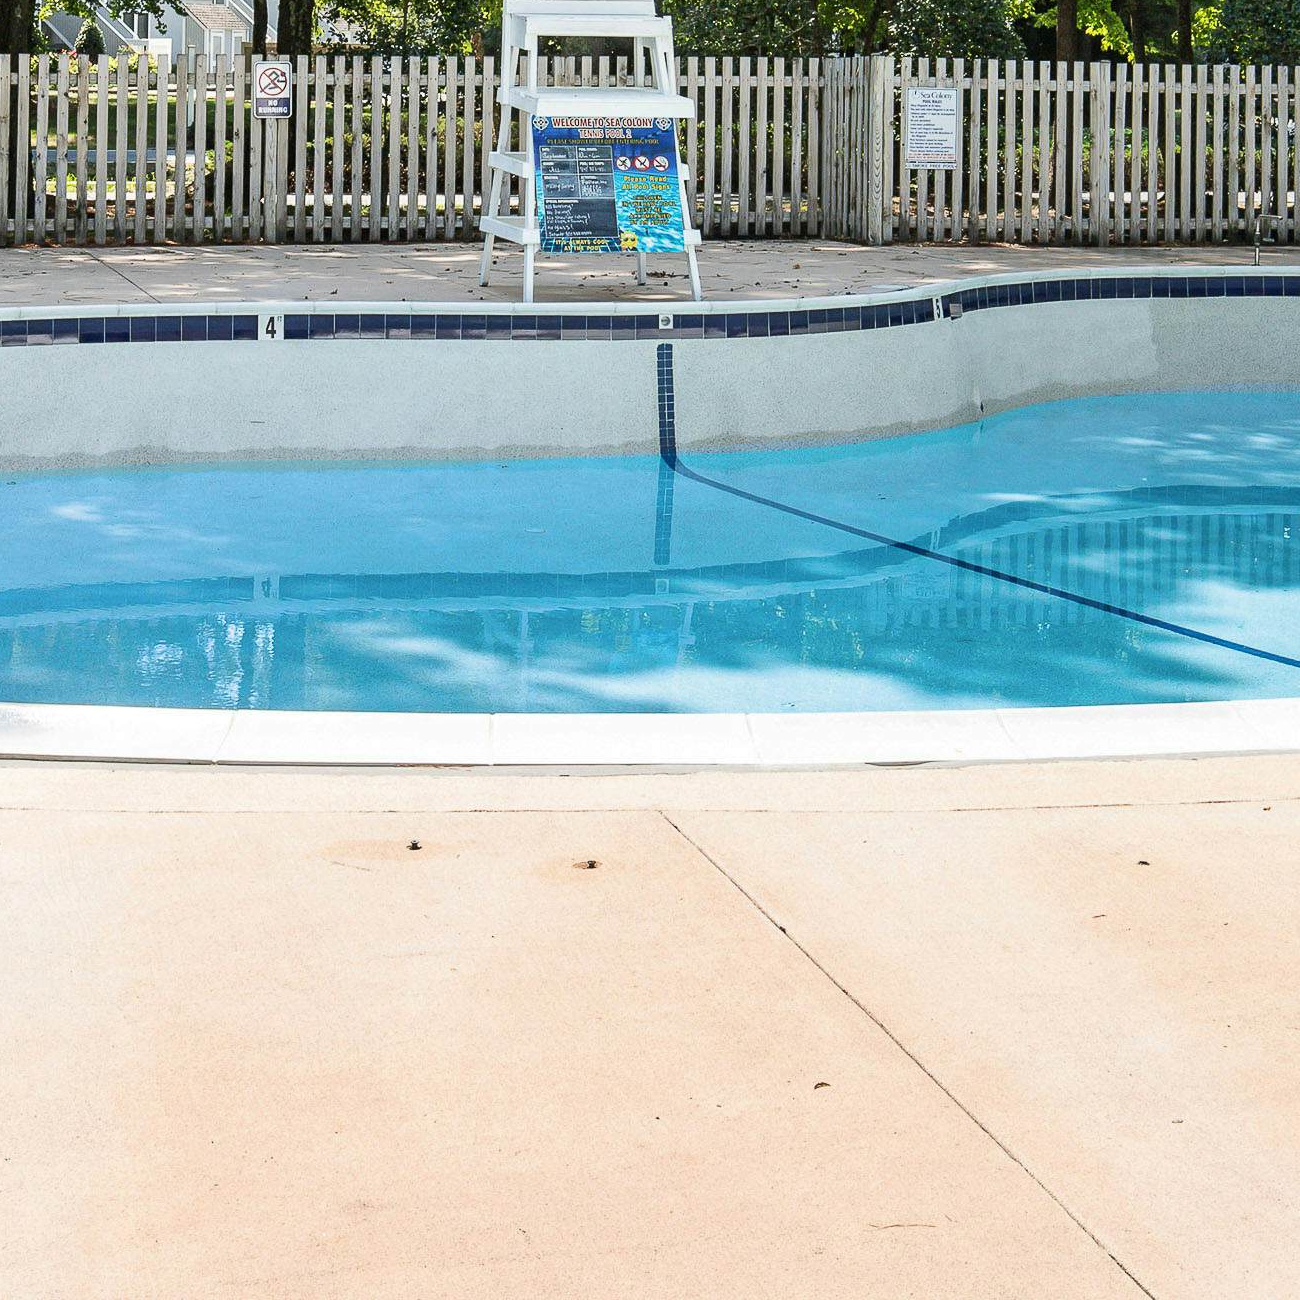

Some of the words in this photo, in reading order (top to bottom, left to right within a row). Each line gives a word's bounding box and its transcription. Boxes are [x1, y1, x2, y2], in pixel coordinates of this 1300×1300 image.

[553, 118, 593, 127] WELCOME
[594, 118, 604, 127] TO
[606, 118, 621, 127] SEA
[622, 118, 653, 127] COLONY
[579, 129, 604, 138] TENNIS
[605, 129, 625, 138] POOL
[626, 129, 632, 138] 2
[935, 298, 941, 319] 5
[265, 316, 277, 339] 4
